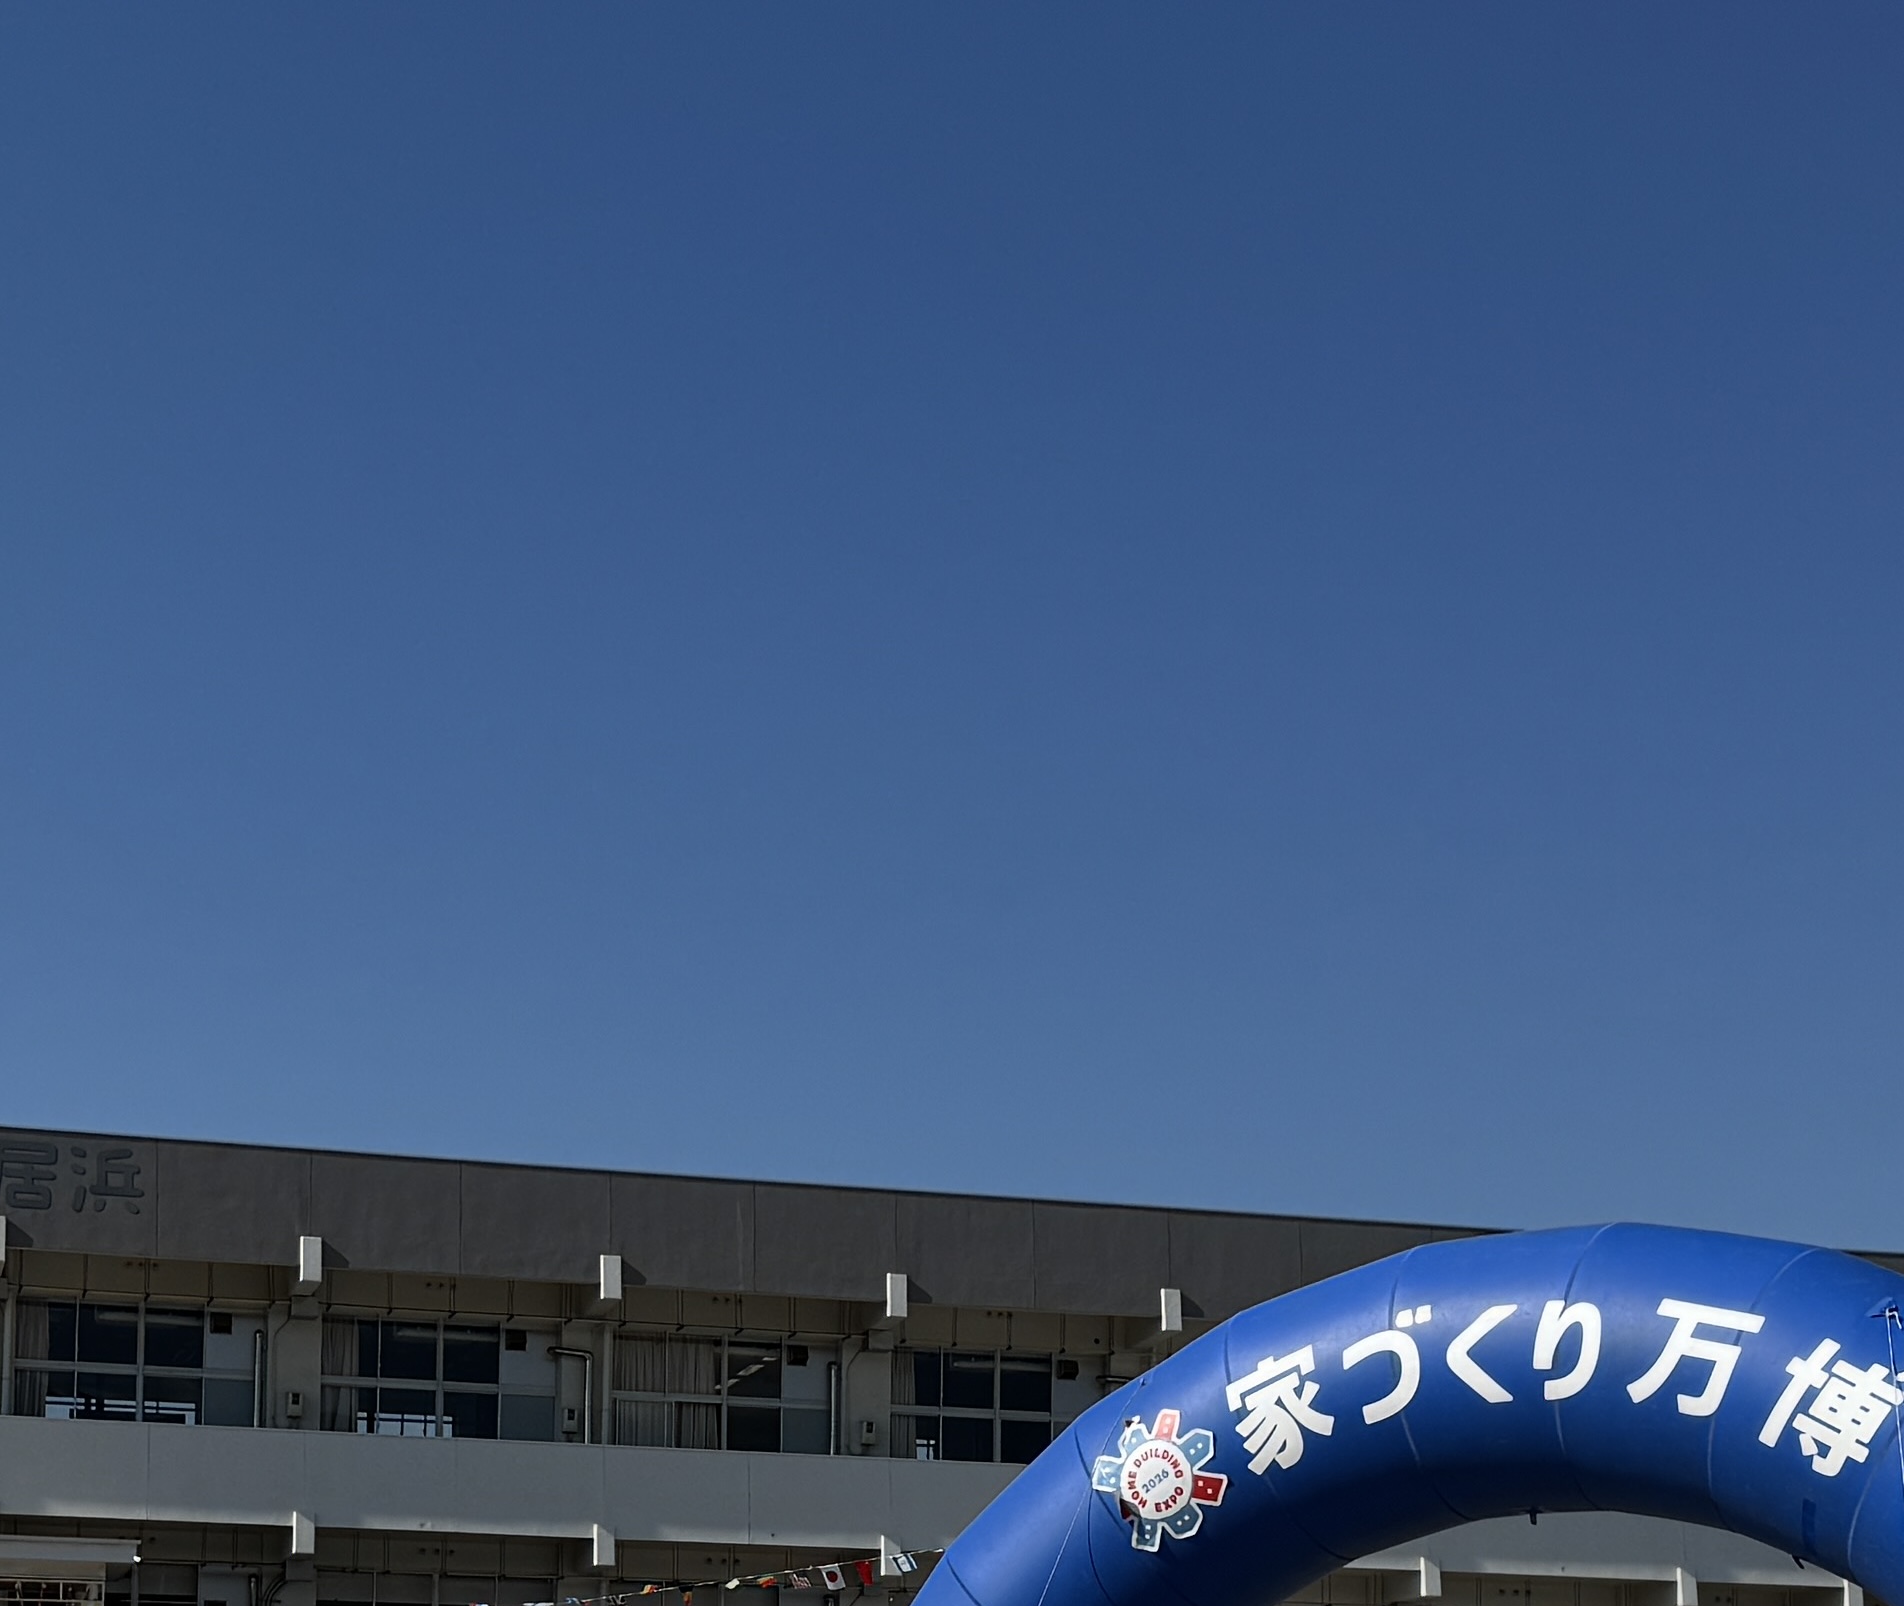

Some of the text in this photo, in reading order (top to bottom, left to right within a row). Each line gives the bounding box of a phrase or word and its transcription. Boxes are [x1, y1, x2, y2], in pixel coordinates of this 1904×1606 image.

[1127, 1470, 1148, 1509] HOME
[1154, 1486, 1184, 1513] EXPO
[1141, 1468, 1170, 1494] 2026
